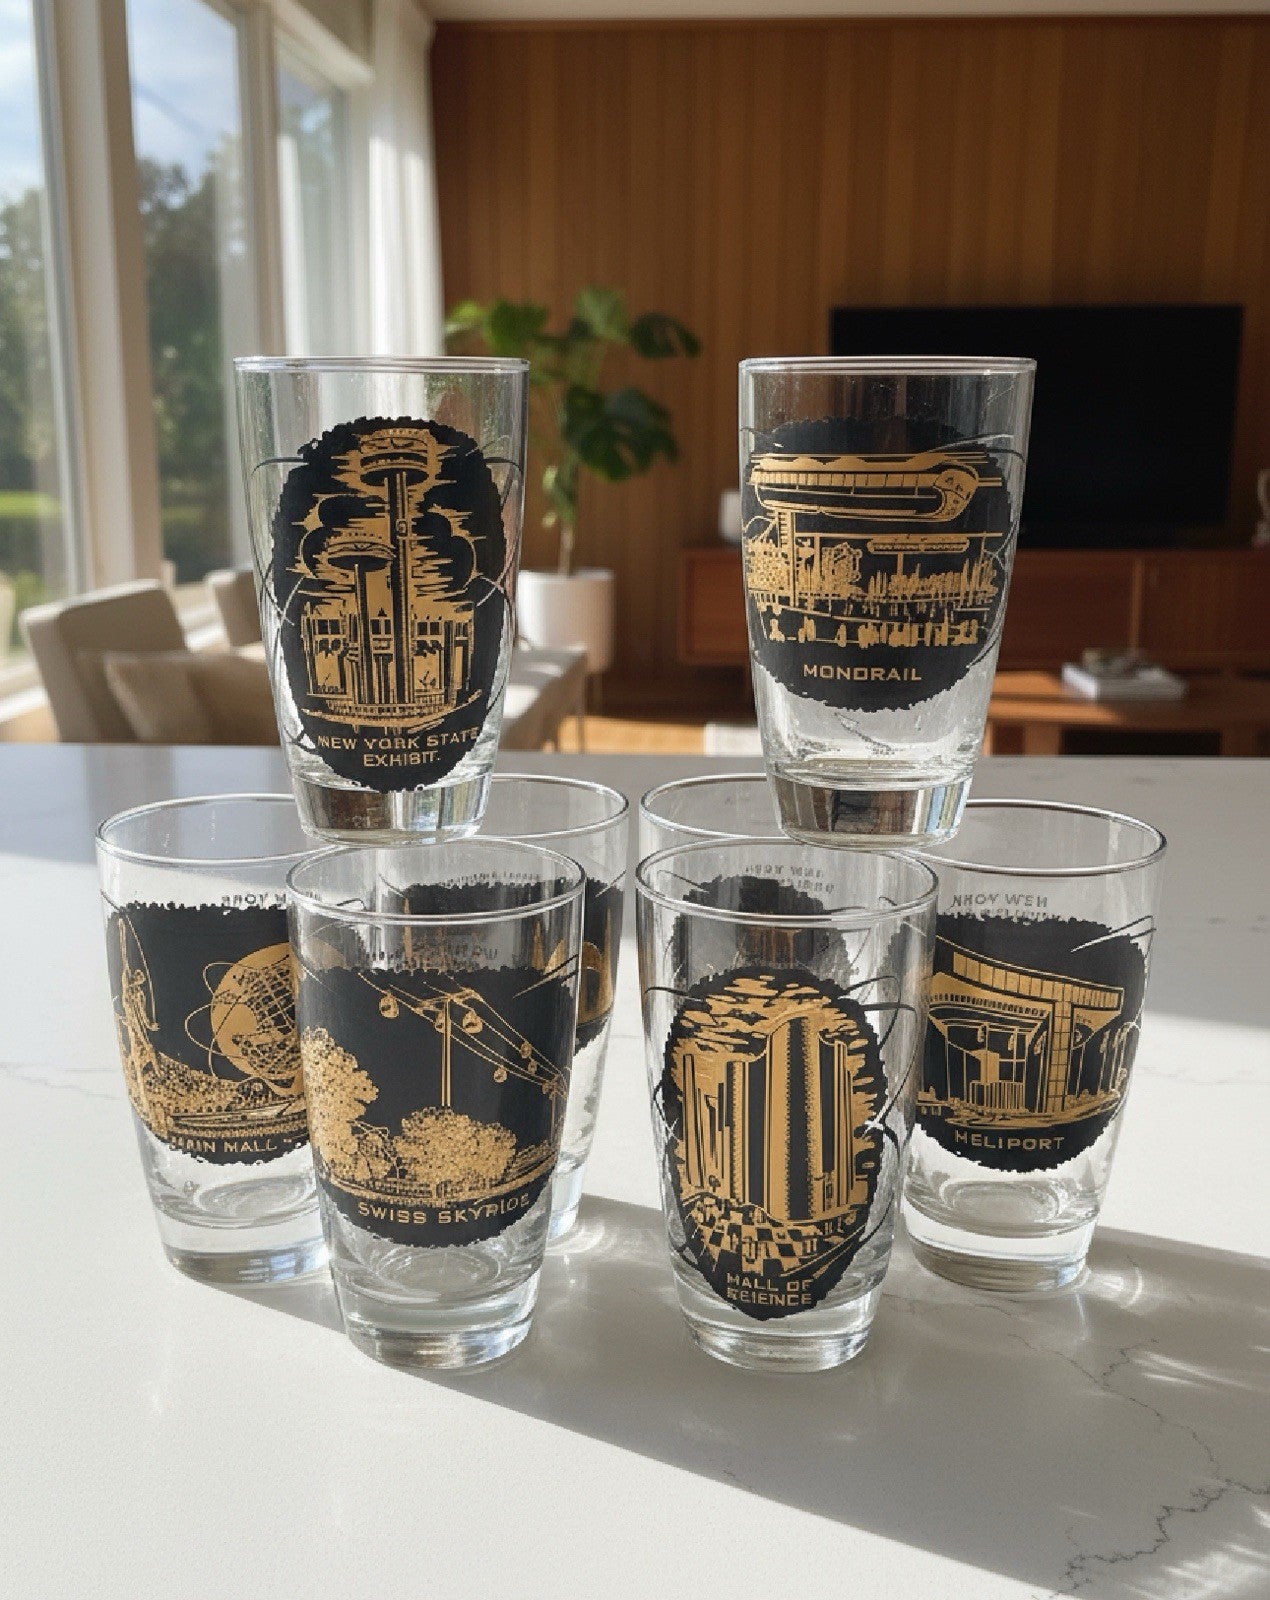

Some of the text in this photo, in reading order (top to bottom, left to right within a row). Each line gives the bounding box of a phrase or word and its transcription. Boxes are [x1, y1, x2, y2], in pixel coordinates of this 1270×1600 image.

[803, 664, 922, 680] MONORAIL
[317, 727, 480, 750] NEW YORK STATE
[223, 1139, 278, 1152] MALL
[357, 1202, 427, 1224] SWISS
[786, 1279, 814, 1292] OF
